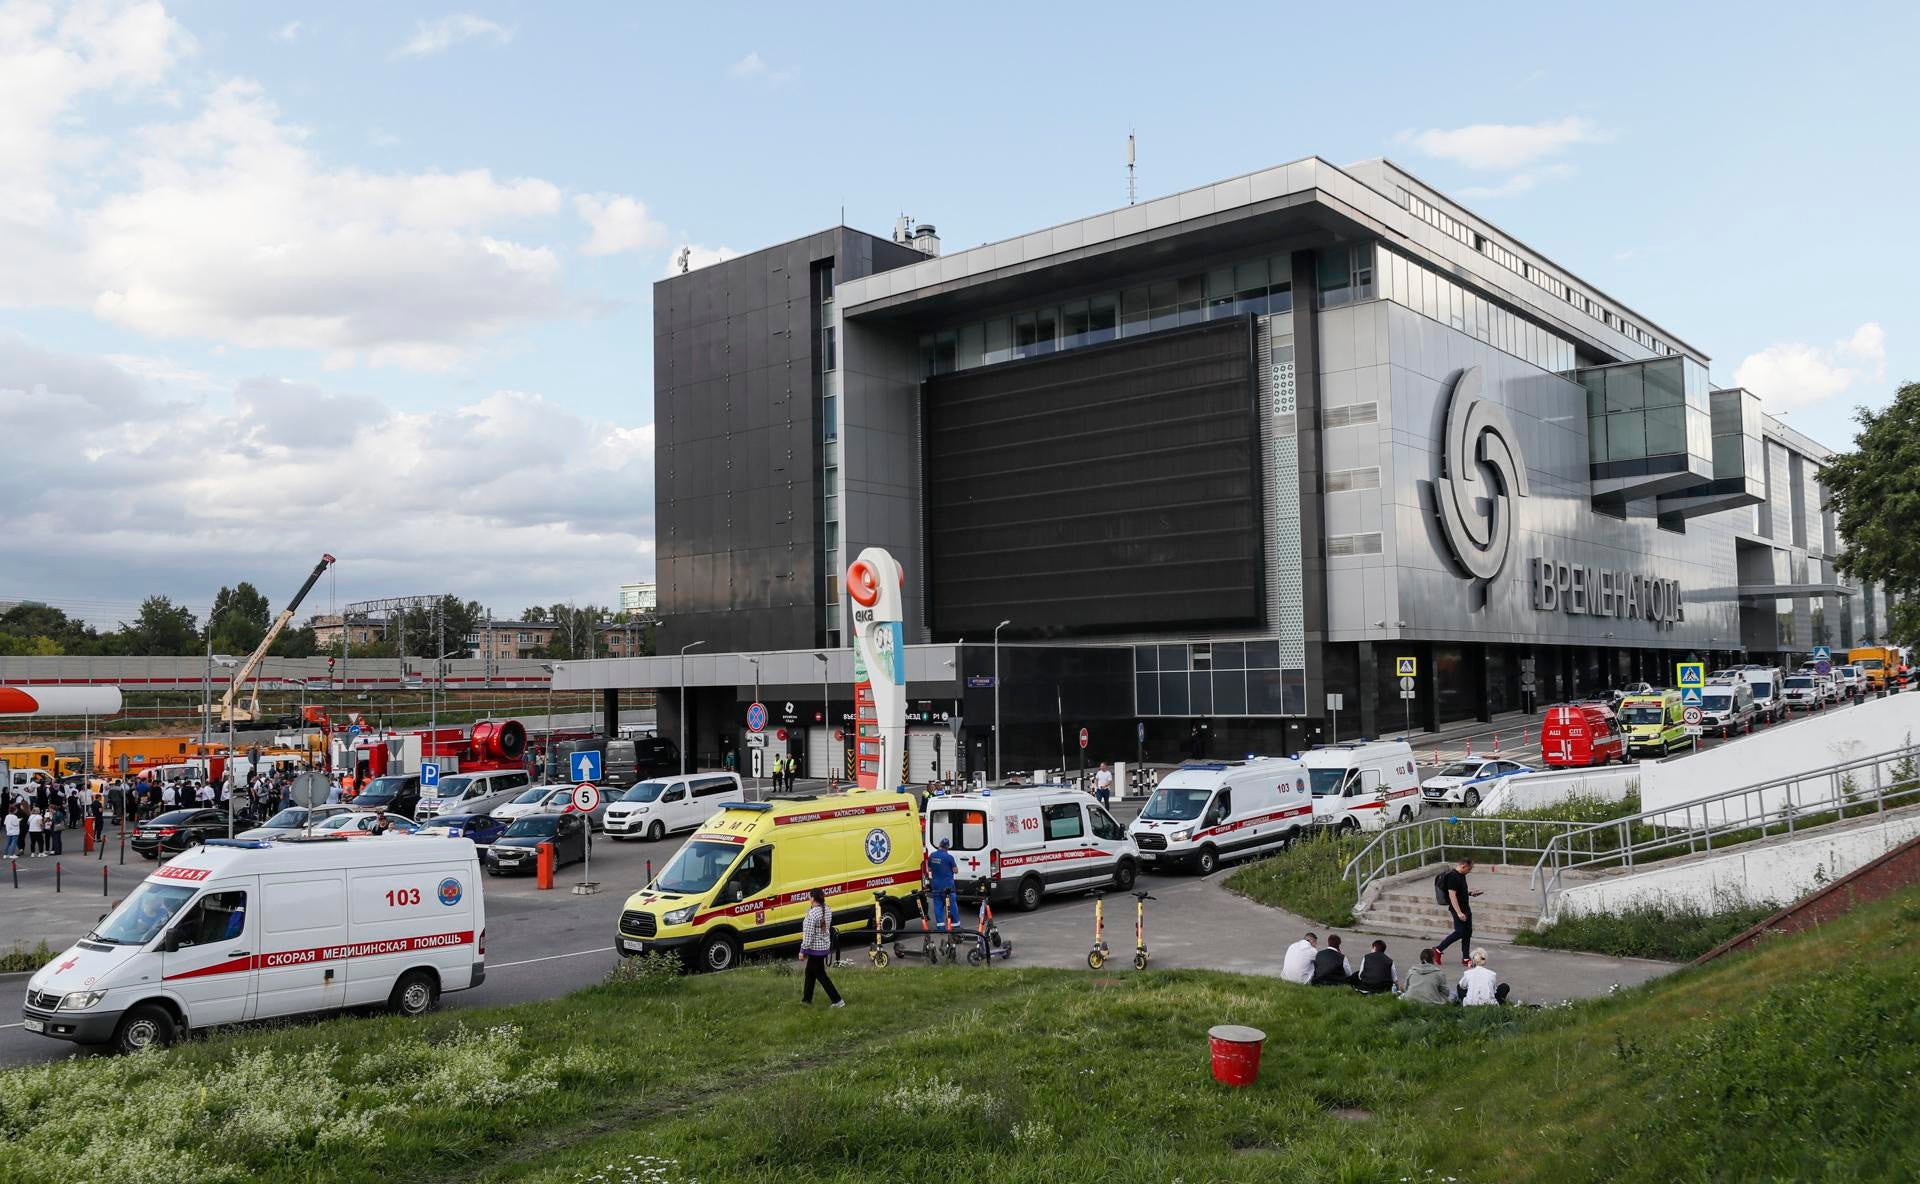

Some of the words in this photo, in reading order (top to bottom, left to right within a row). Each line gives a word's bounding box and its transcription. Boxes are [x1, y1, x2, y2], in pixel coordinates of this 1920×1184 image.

[1686, 712, 1698, 720] 20
[425, 765, 437, 784] P
[1277, 783, 1290, 794] 103
[581, 791, 590, 804] 5
[790, 813, 821, 823] МЕДИЦИНА
[834, 808, 866, 818] КАТАСТРОФ
[1020, 817, 1039, 830] 103
[1003, 857, 1023, 866] СКОРАЯ
[1025, 853, 1062, 863] МЕДИЦИНСКАЯ
[385, 888, 421, 907] 103
[735, 901, 764, 914] СКОРАЯ
[790, 886, 842, 902] МЕДИСКАЯ
[866, 876, 895, 887] ПОМОЩЬ
[267, 950, 315, 966] СКОРАЯ
[322, 940, 407, 959] МЕДИЦИНСКАЯ
[414, 934, 462, 948] ПОМОЩЬ
